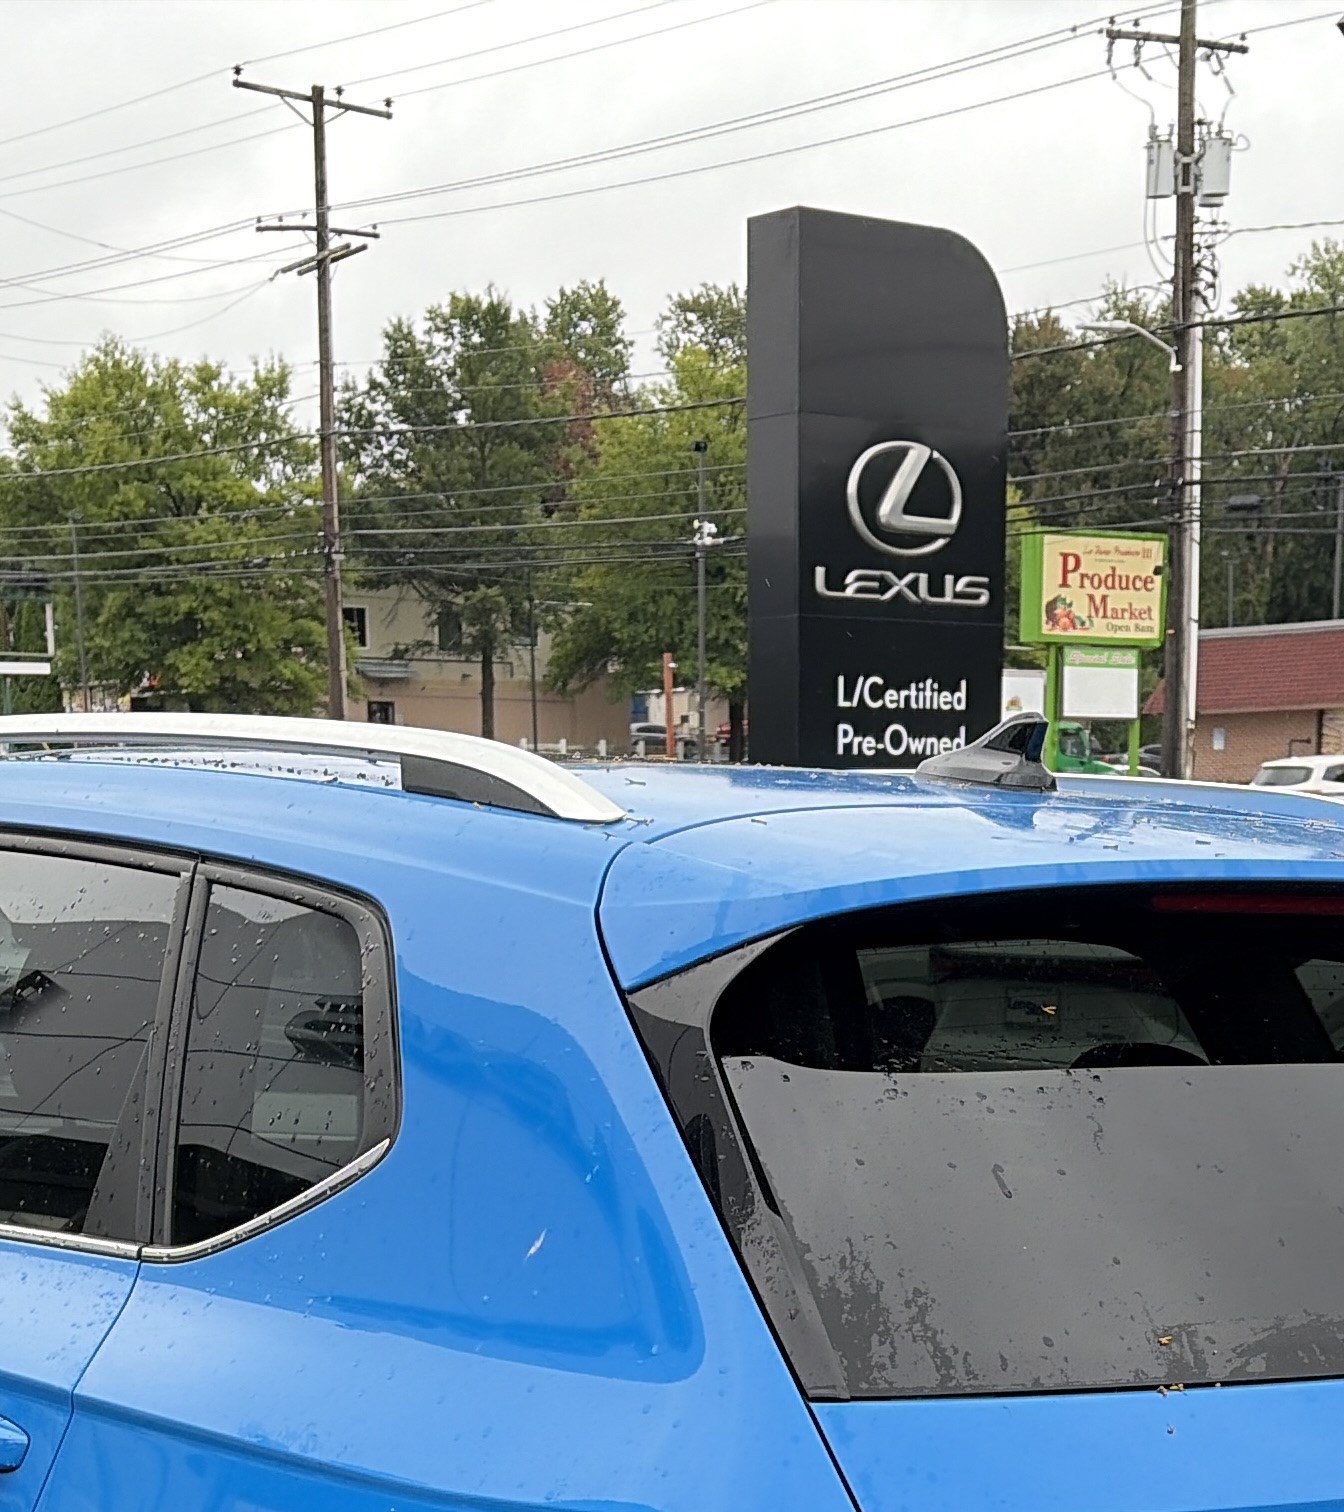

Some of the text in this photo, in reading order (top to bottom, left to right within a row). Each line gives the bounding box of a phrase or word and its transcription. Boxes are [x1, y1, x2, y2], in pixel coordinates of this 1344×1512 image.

[814, 565, 990, 606] LEXUS
[1057, 551, 1155, 592] Produce
[1086, 593, 1154, 621] Market
[1105, 622, 1155, 634] Open 8am
[837, 674, 967, 711] L/Certified
[837, 722, 966, 756] Pre-Owned
